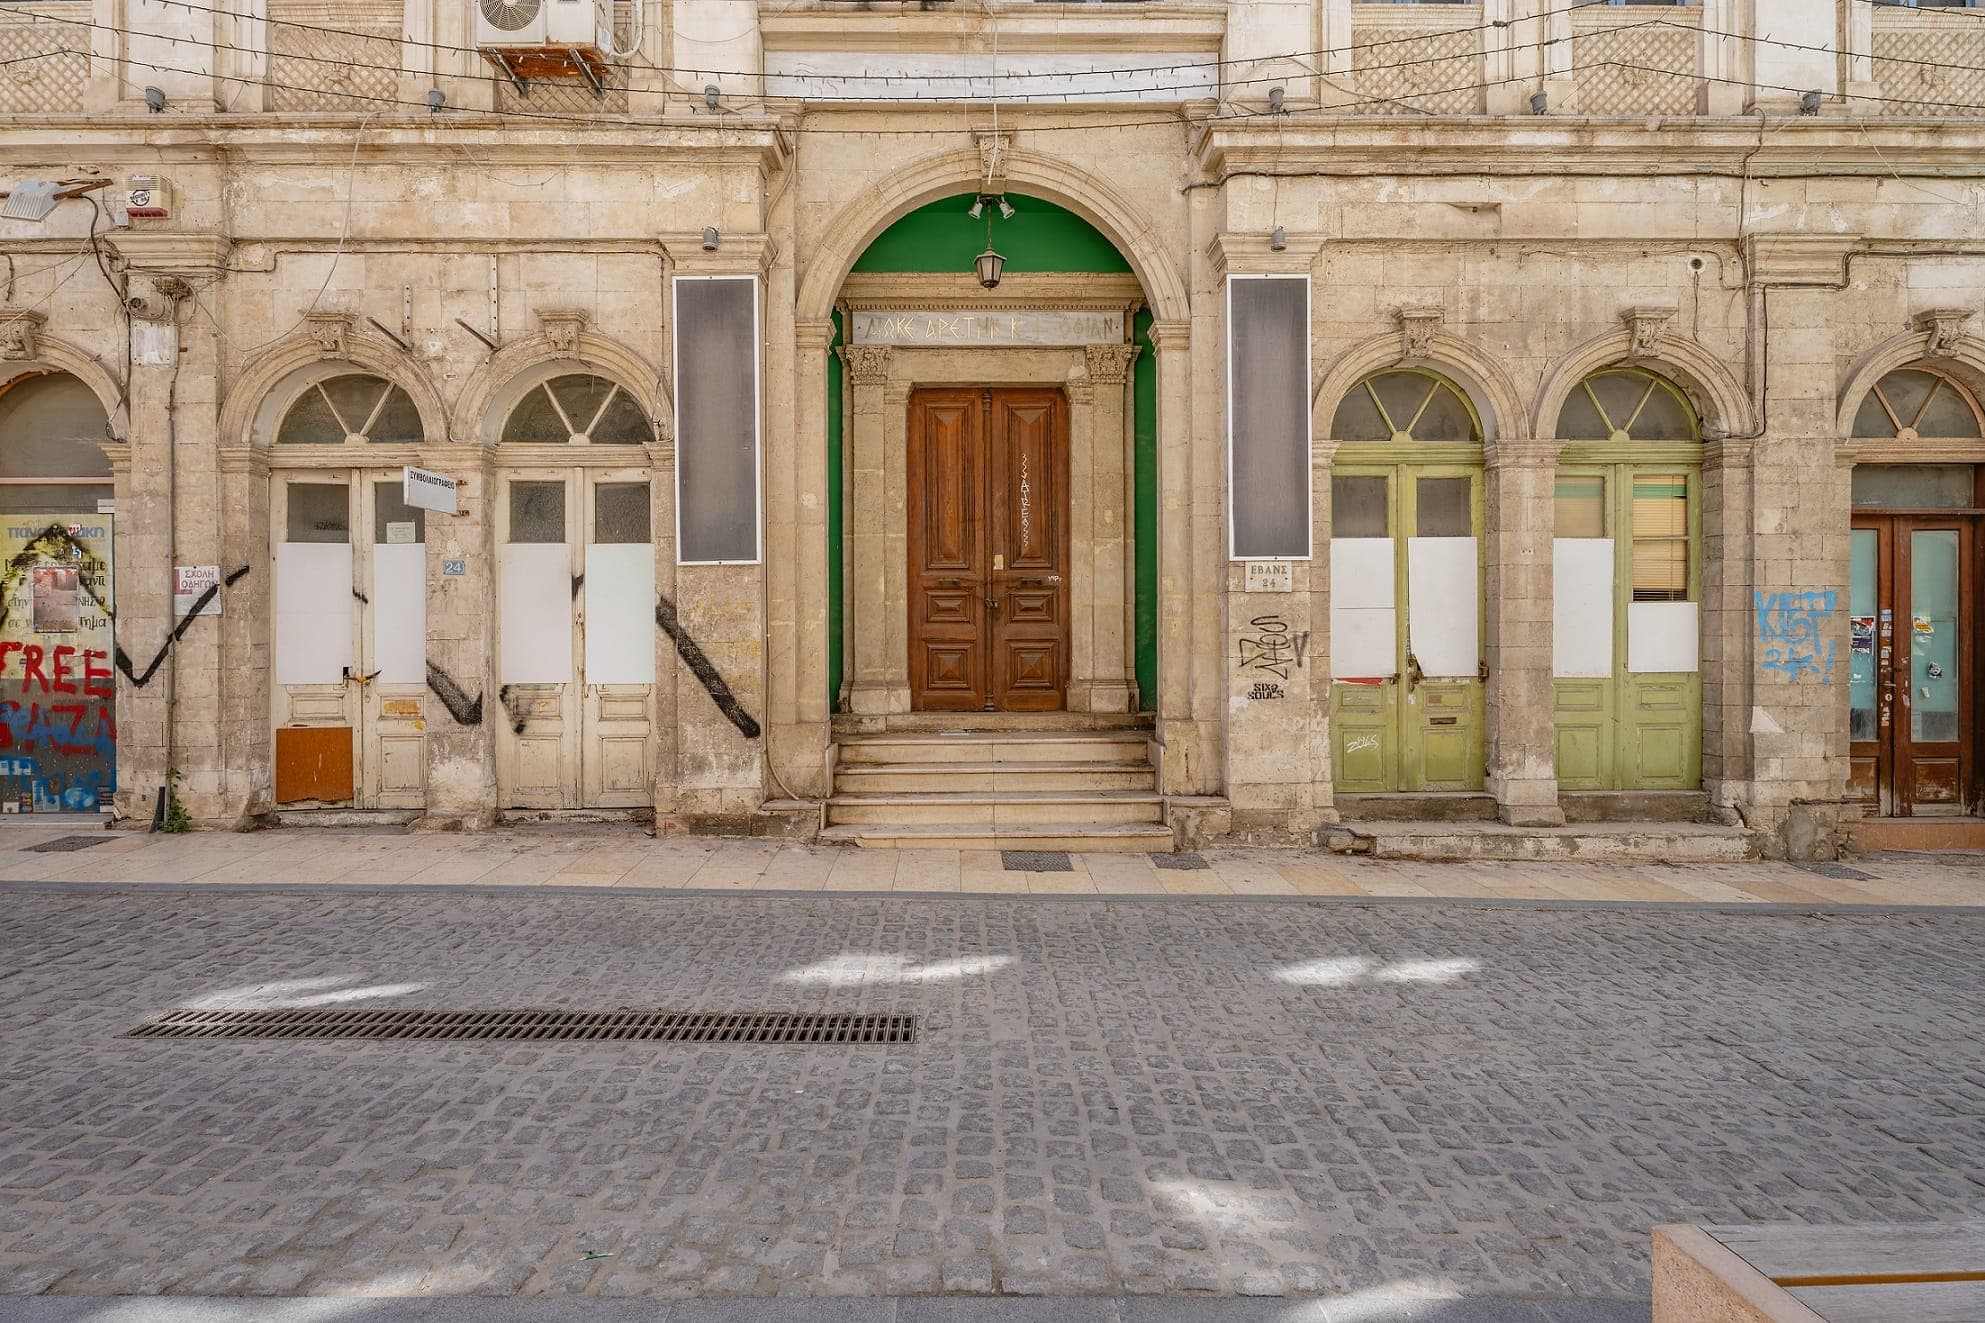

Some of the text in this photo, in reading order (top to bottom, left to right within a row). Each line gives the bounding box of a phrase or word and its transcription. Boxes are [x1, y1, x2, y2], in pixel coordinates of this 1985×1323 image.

[1059, 316, 1114, 340] ΟΦΙΑΝ
[445, 562, 462, 573] 24
[1251, 565, 1287, 574] ΕΒΑΝΣ
[1262, 578, 1276, 587] 24
[0, 641, 114, 698] FREE
